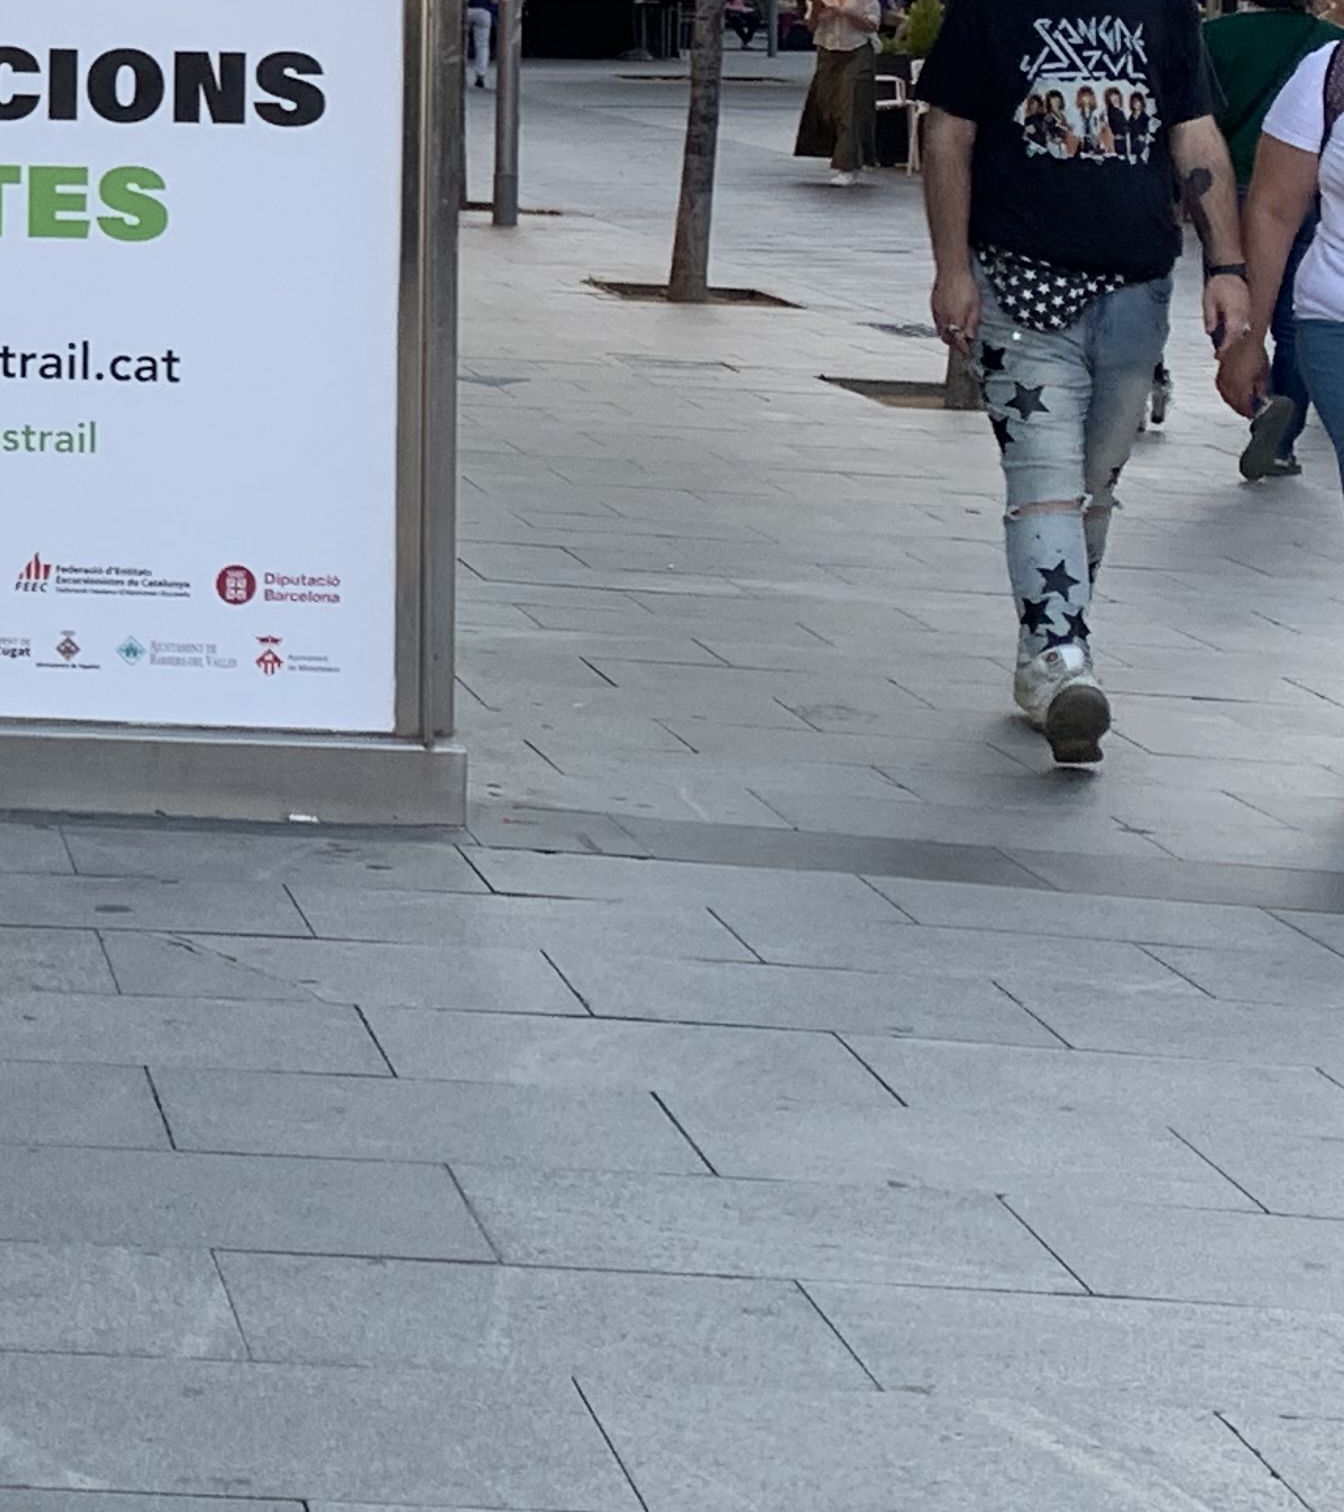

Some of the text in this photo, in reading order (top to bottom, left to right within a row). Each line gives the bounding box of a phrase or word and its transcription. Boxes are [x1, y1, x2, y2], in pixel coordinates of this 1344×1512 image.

[15, 582, 48, 593] FEEC
[264, 572, 340, 588] Diputació
[264, 589, 340, 604] Barcelona
